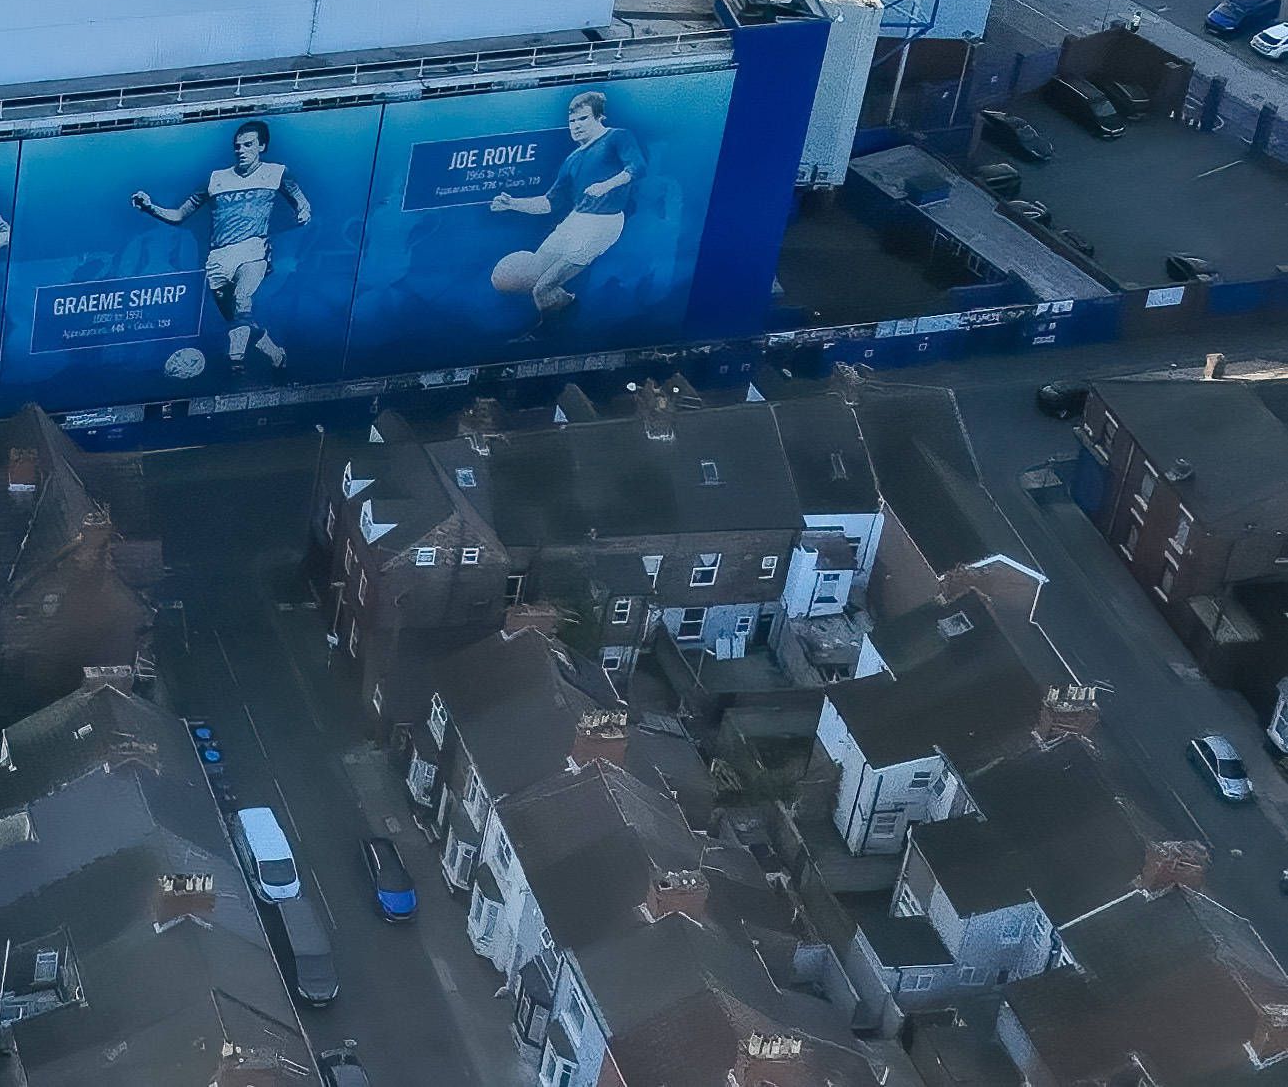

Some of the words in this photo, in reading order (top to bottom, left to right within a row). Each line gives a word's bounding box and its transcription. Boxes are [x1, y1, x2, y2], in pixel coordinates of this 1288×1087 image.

[448, 149, 479, 170] JOE
[483, 143, 538, 166] ROYLE
[53, 291, 124, 315] GRAEME
[129, 284, 187, 307] SHARP
